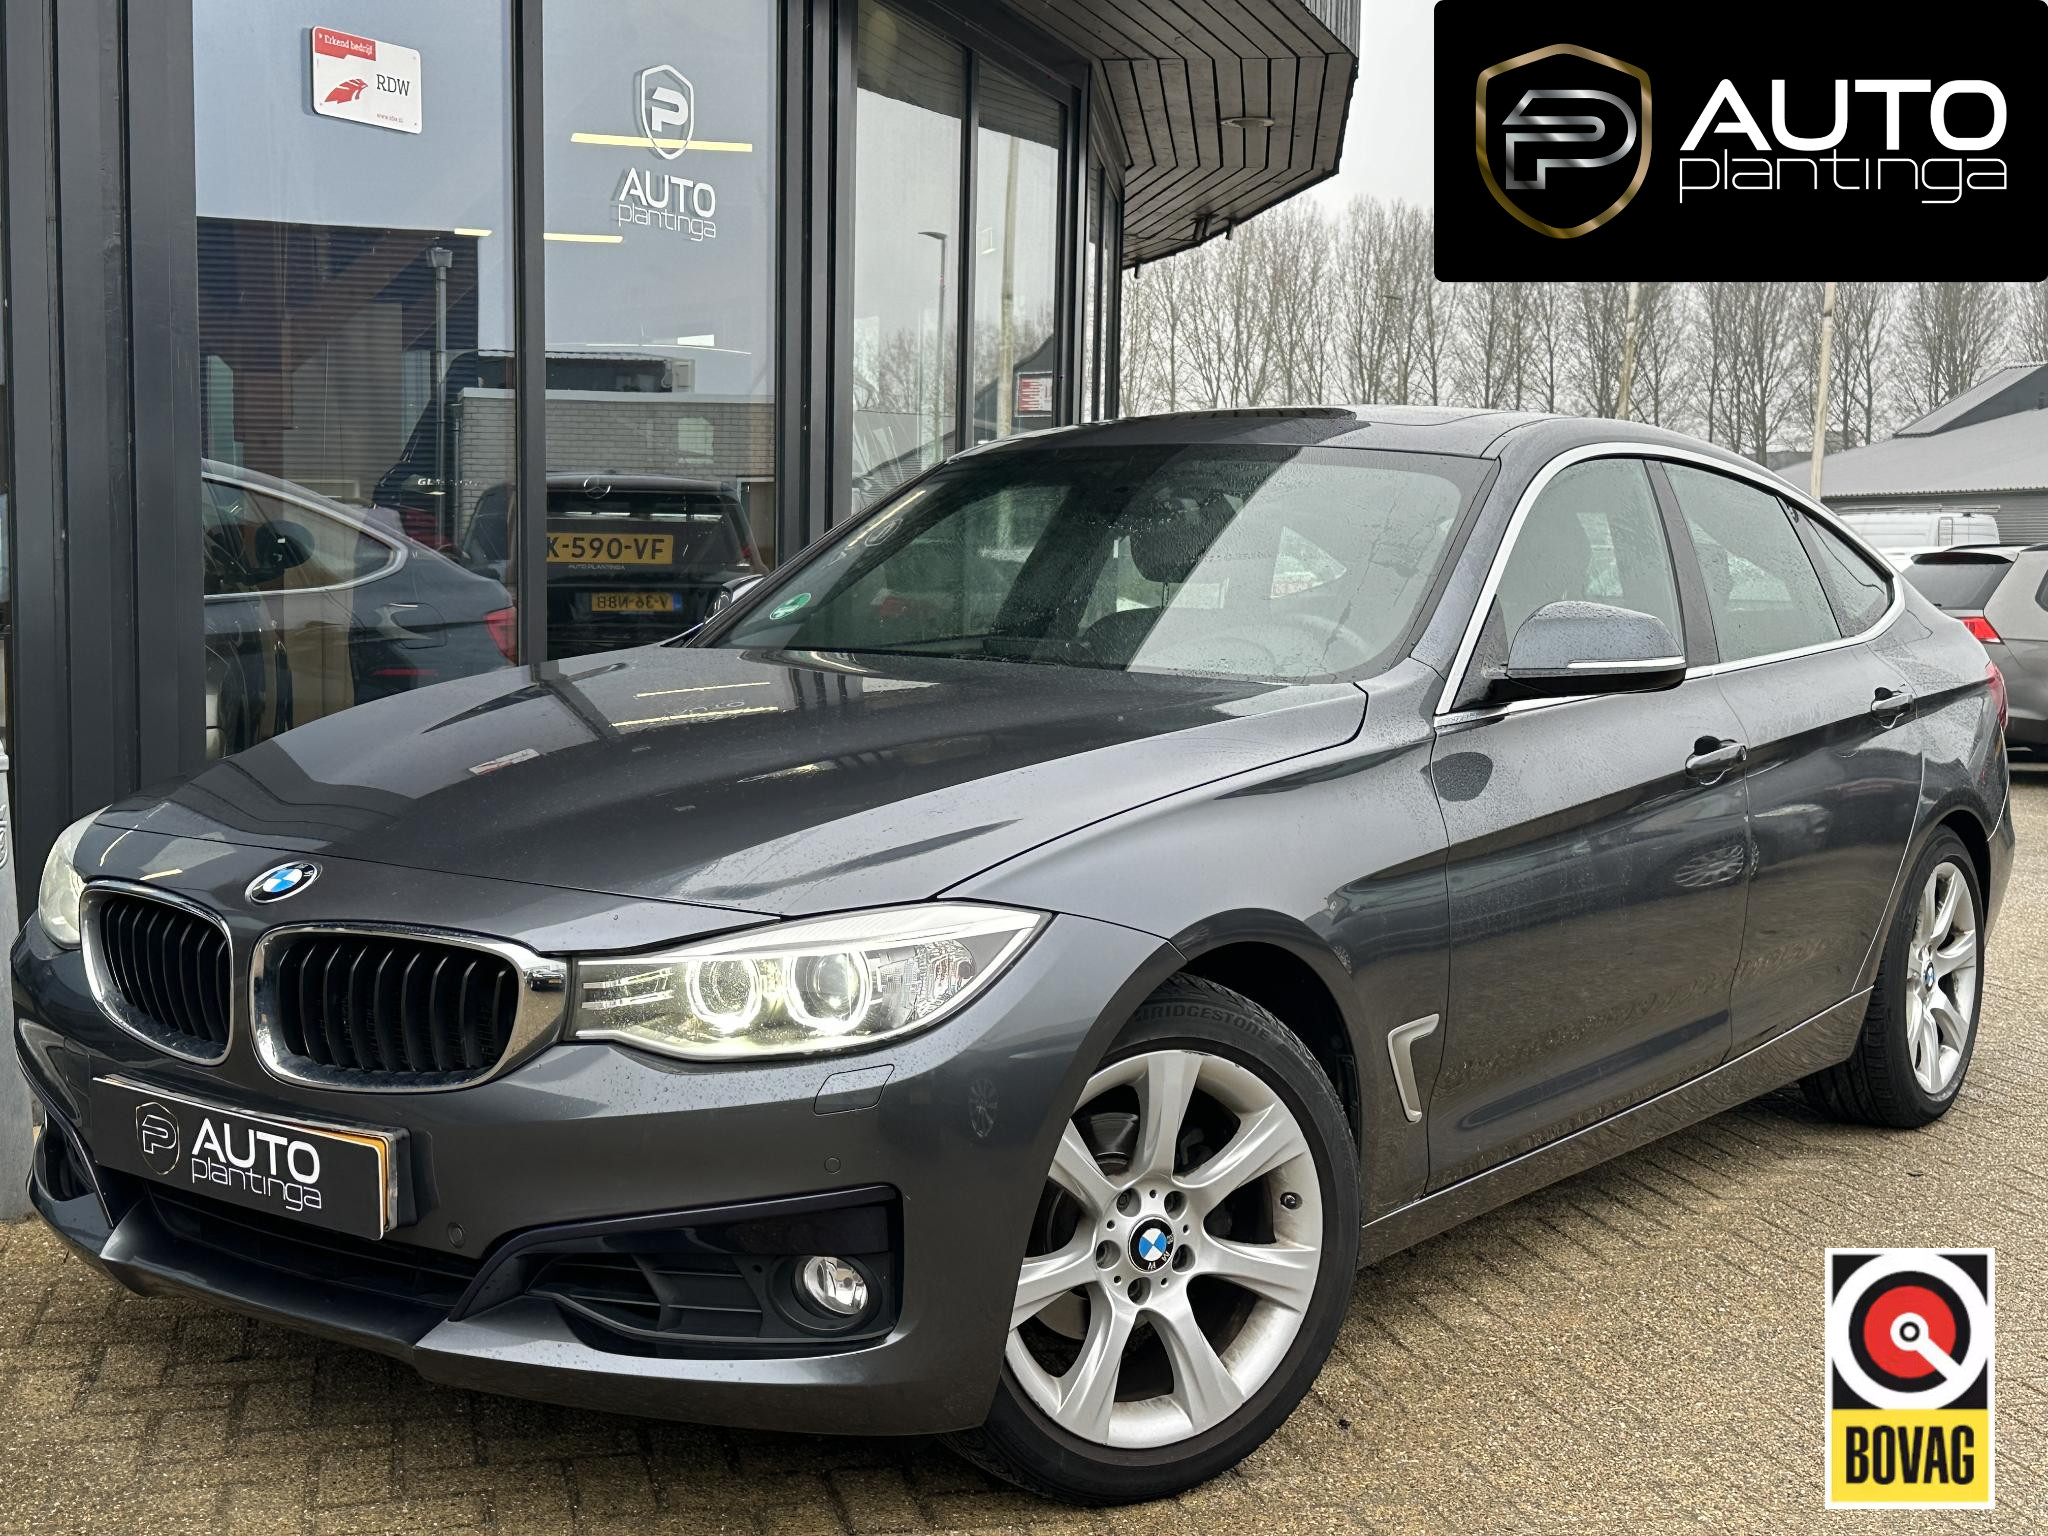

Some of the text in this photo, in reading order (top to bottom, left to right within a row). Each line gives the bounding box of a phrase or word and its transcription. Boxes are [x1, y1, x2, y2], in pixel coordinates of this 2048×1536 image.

[324, 34, 349, 49] Erkend
[376, 73, 411, 97] RDW
[618, 167, 716, 218] AUTO
[618, 203, 717, 242] plantinga
[191, 1117, 321, 1185] AUTO
[191, 1157, 322, 1212] plantinga
